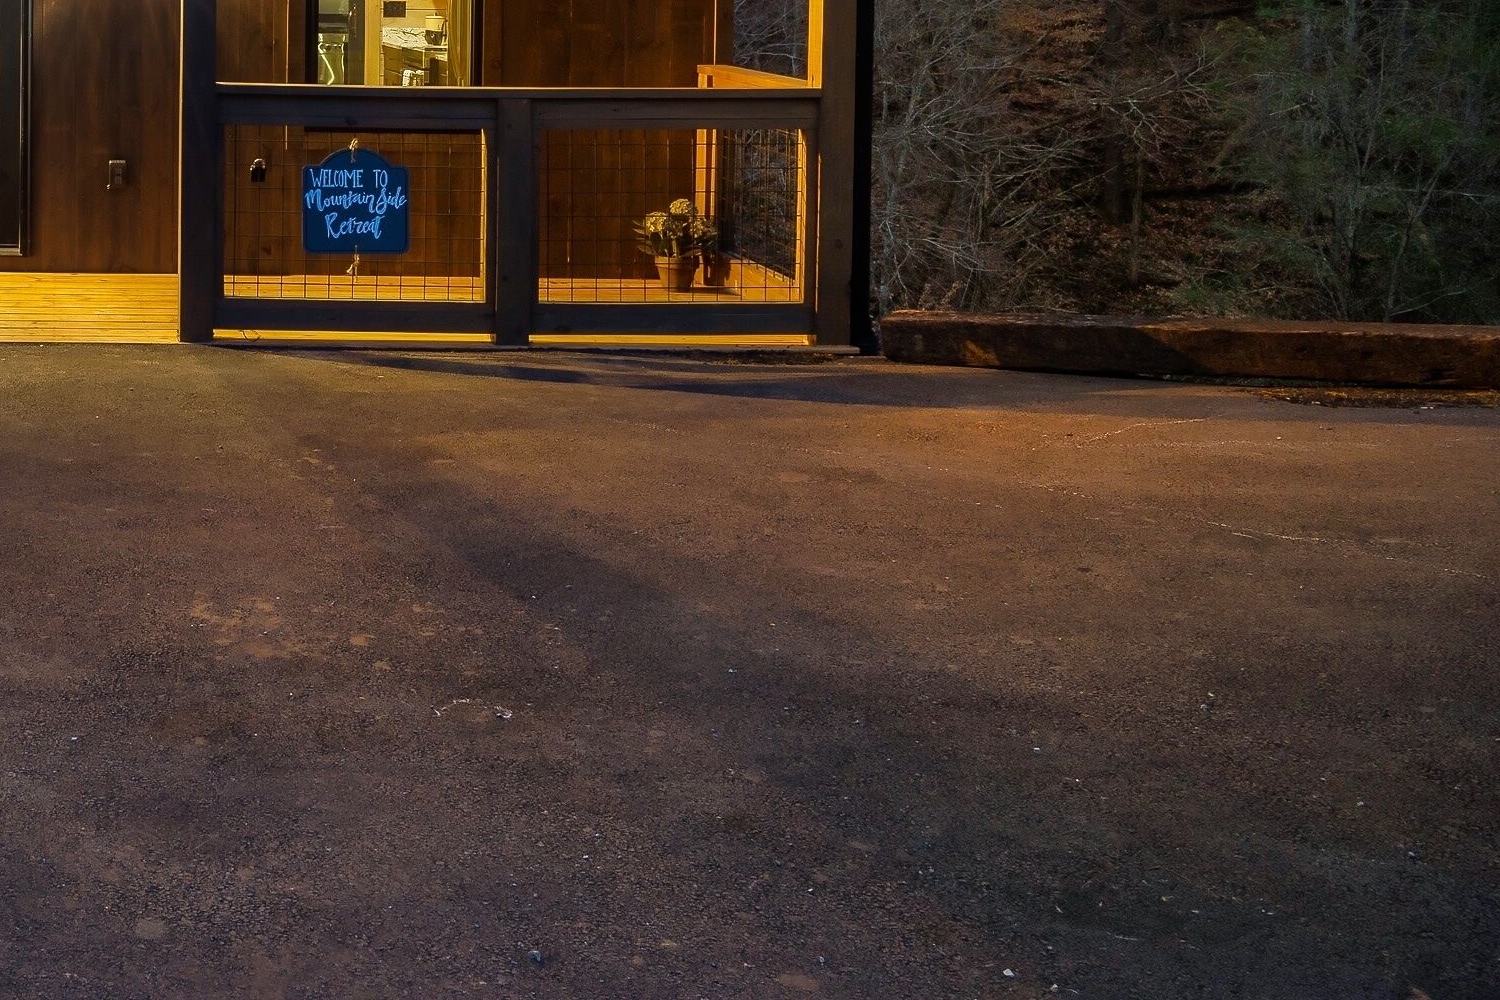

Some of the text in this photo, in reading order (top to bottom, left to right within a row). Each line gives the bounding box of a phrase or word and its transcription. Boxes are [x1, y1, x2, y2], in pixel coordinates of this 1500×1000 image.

[309, 168, 388, 188] WELCOME TO
[325, 212, 385, 239] Retreat
